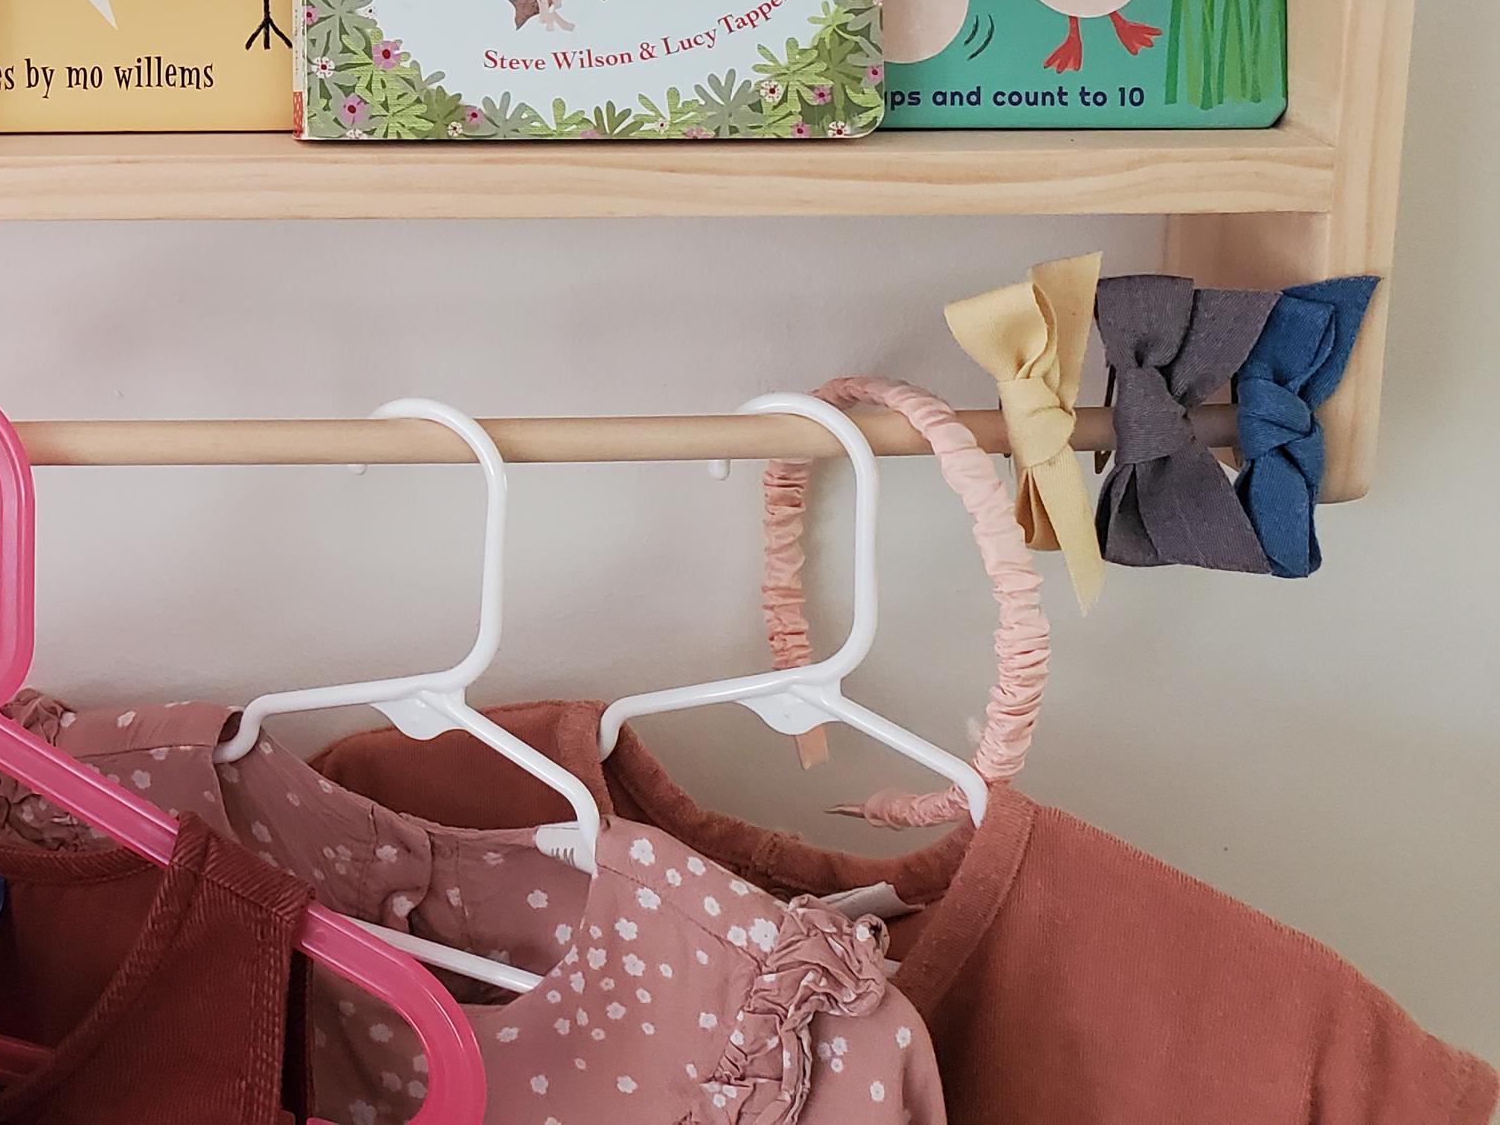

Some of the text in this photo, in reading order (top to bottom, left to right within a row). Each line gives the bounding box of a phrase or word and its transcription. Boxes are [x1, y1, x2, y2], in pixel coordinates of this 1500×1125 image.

[484, 49, 546, 71] Steve
[551, 49, 633, 70] Wilson
[639, 42, 657, 61] &
[661, 28, 718, 57] Lucy
[24, 58, 55, 99] by
[65, 64, 103, 90] mo
[113, 56, 215, 92] willems
[932, 86, 981, 107] and
[992, 86, 1069, 107] count
[1079, 86, 1108, 107] to
[1118, 86, 1145, 107] 10
